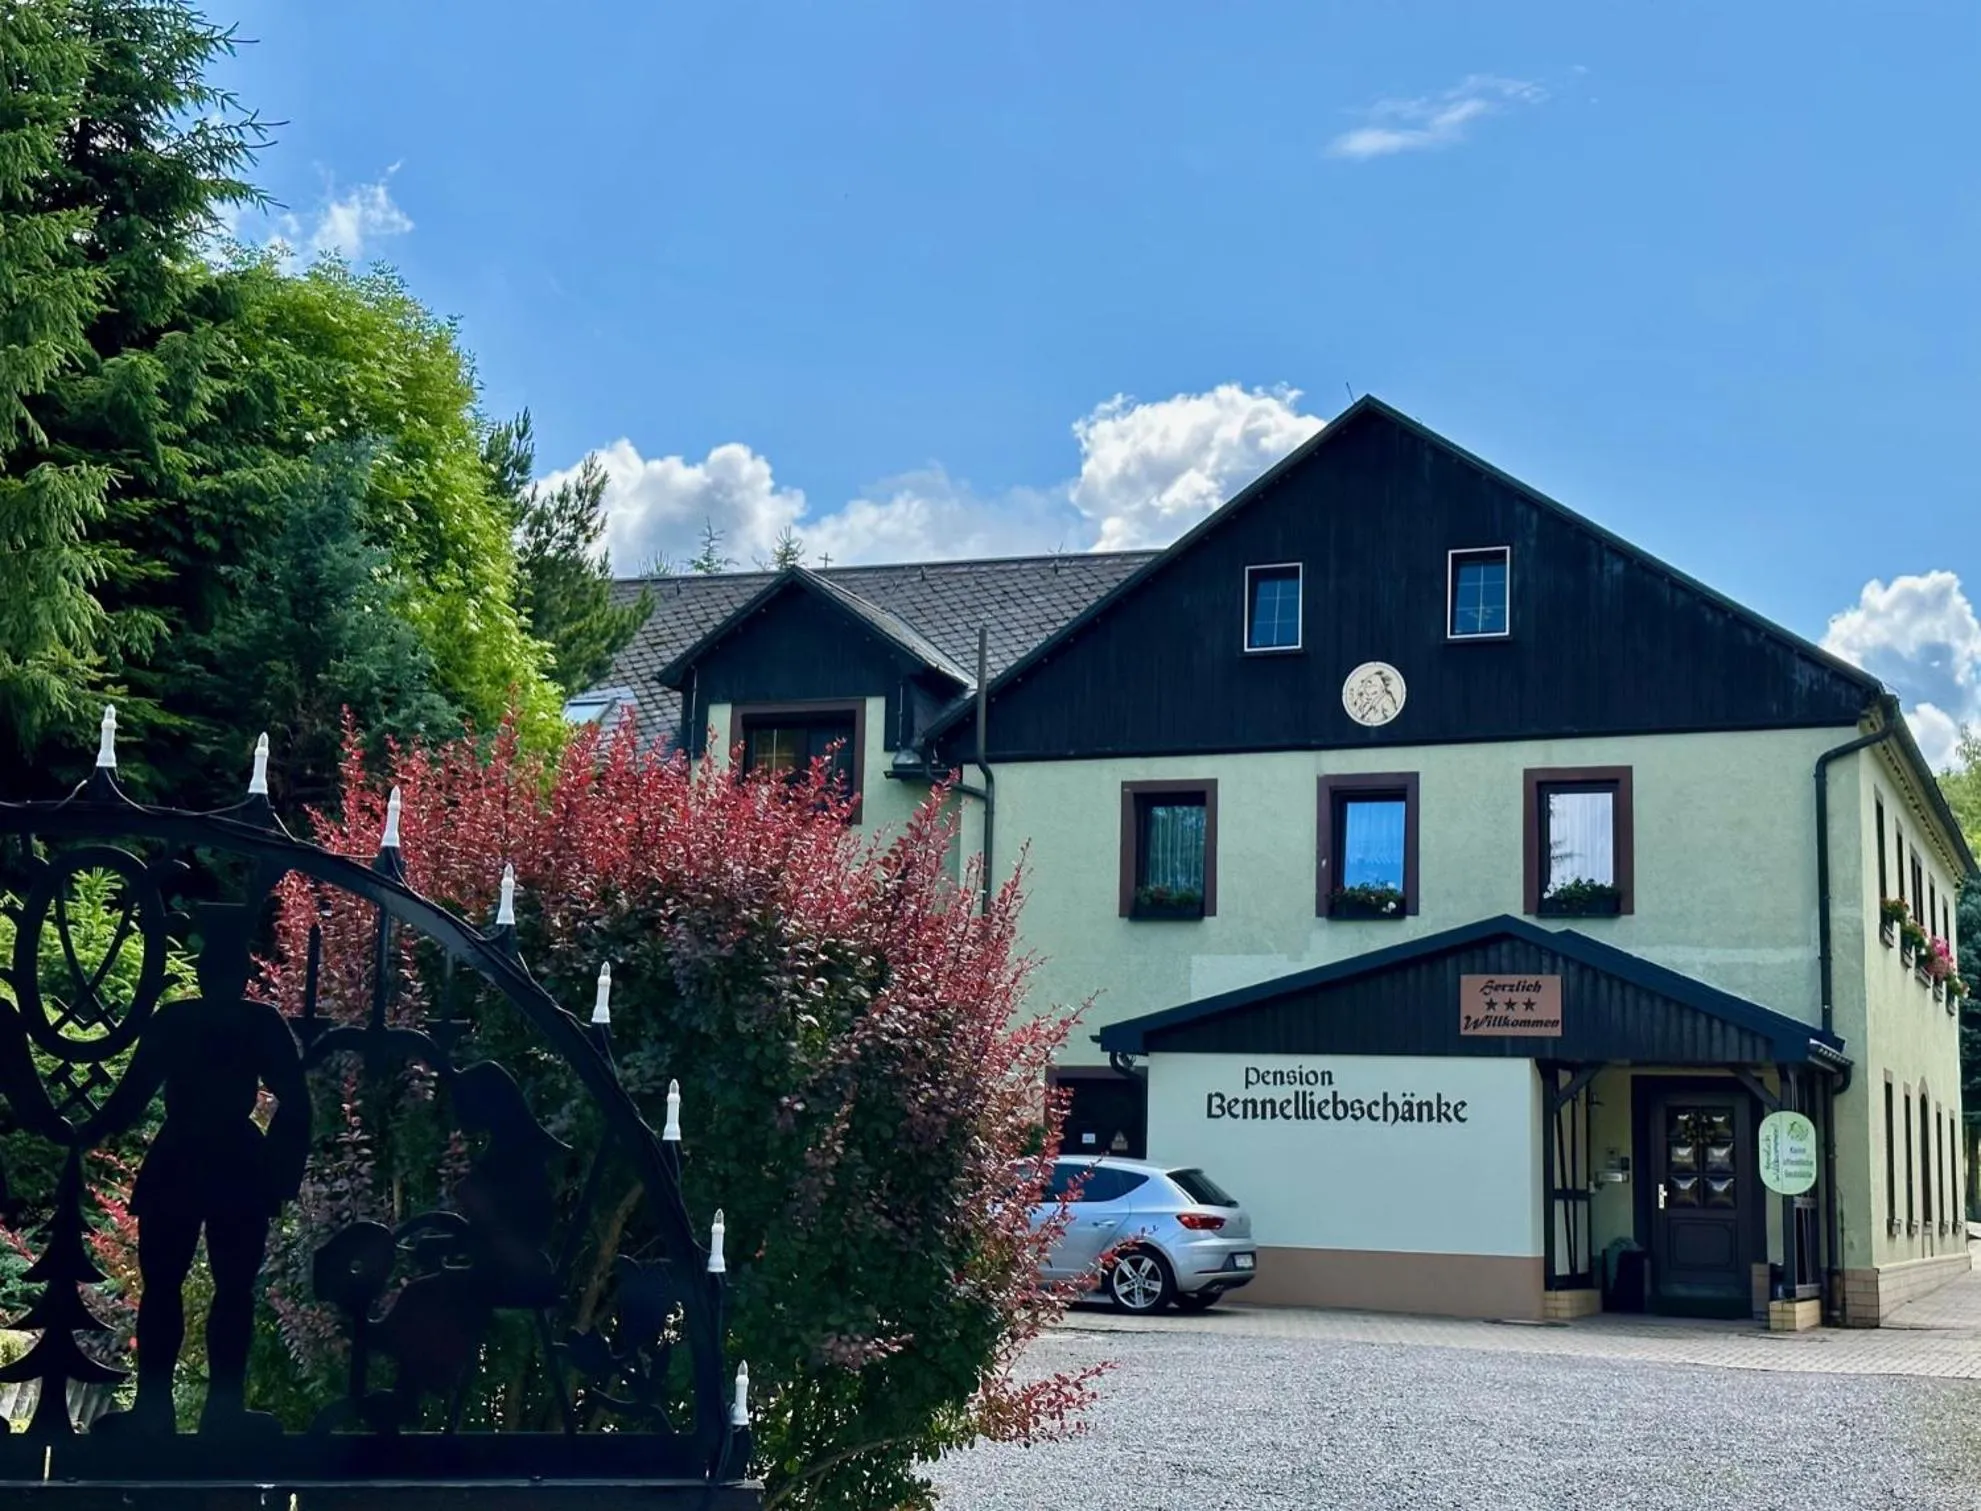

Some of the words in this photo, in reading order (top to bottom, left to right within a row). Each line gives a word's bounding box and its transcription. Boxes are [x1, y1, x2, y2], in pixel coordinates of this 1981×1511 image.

[1479, 979, 1542, 995] Herzlich
[1463, 1014, 1560, 1030] Willkommen
[1244, 1065, 1335, 1090] Pension
[1206, 1090, 1469, 1127] Bennelliebschänke
